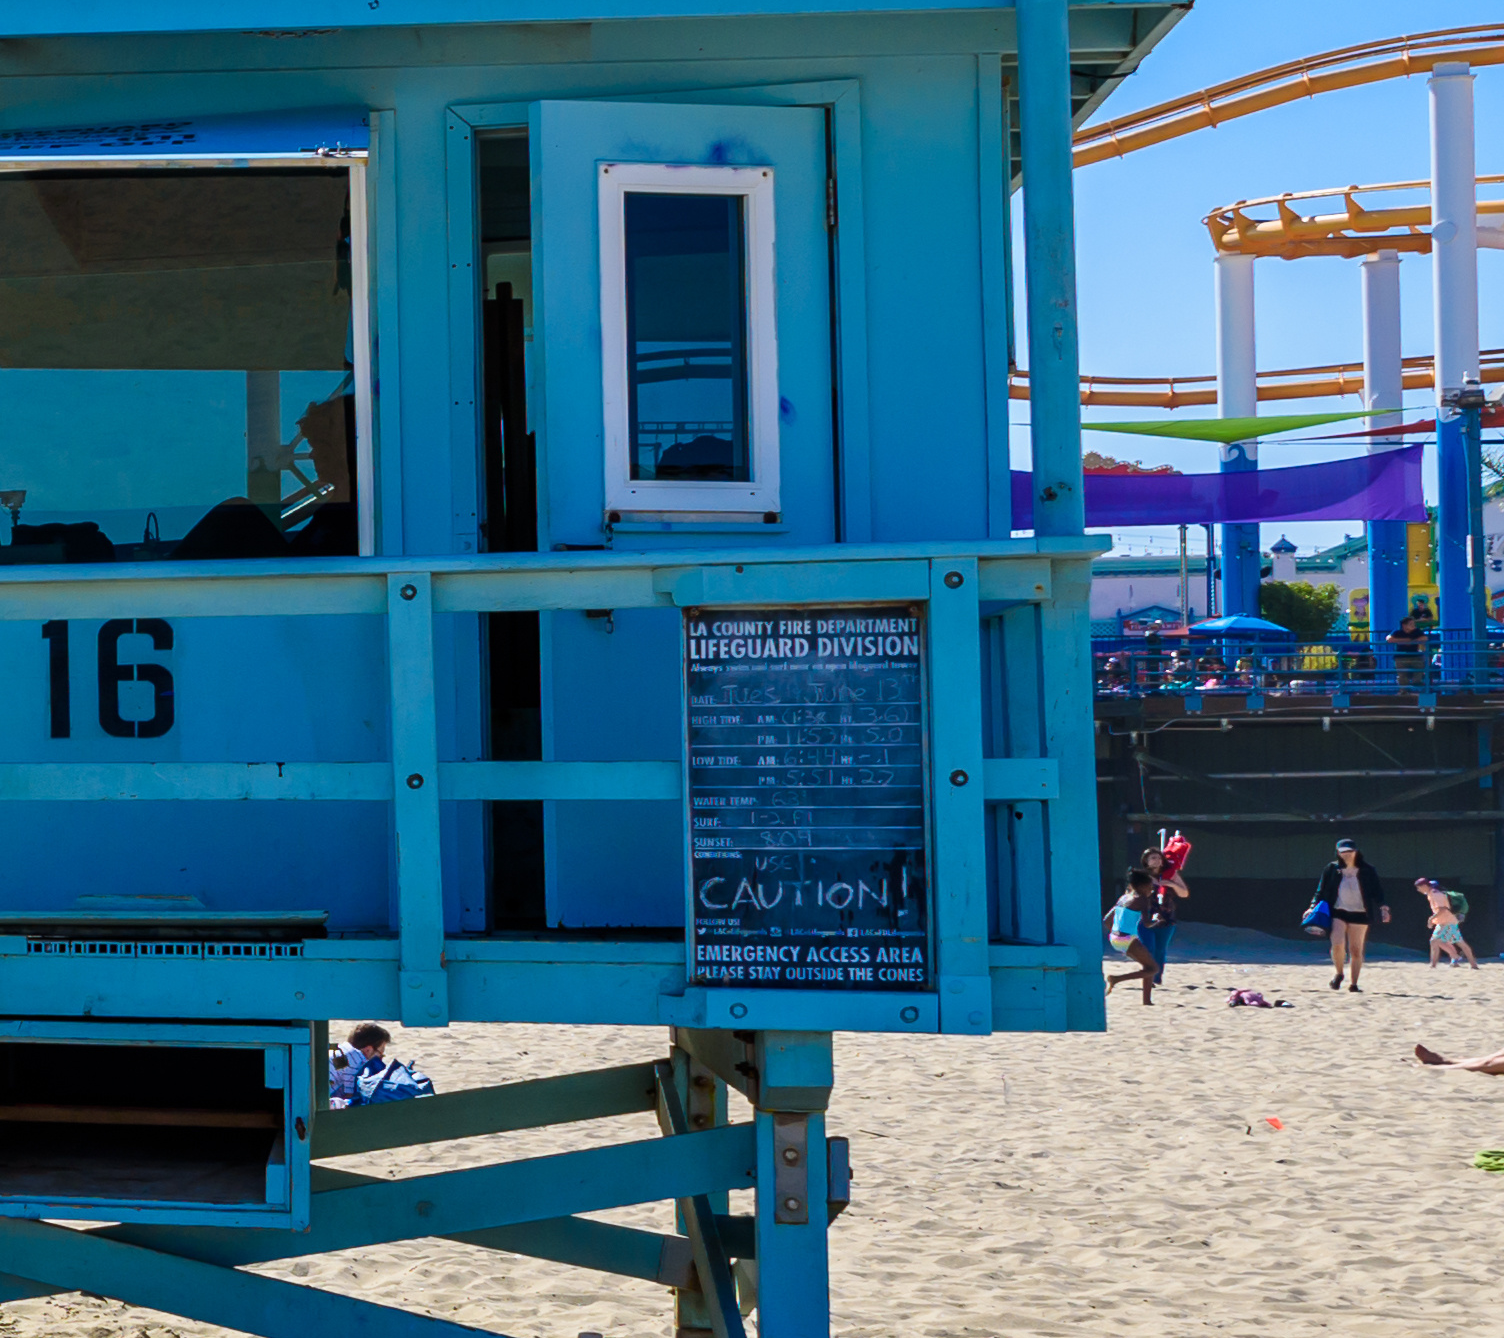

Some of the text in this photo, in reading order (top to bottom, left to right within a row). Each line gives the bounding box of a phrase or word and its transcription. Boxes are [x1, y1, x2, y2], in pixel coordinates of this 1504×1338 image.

[689, 618, 918, 637] LA COUNTY FIRE DEPARTMENT
[690, 635, 919, 659] LIFEGUARD DIVISION
[42, 618, 175, 738] 16
[691, 715, 717, 725] HIGH
[692, 756, 715, 766] LOW
[696, 945, 924, 963] EMERGENCY ACCESS AREA
[696, 965, 924, 982] PLEASE STAY OUTSIDE THE CONES
